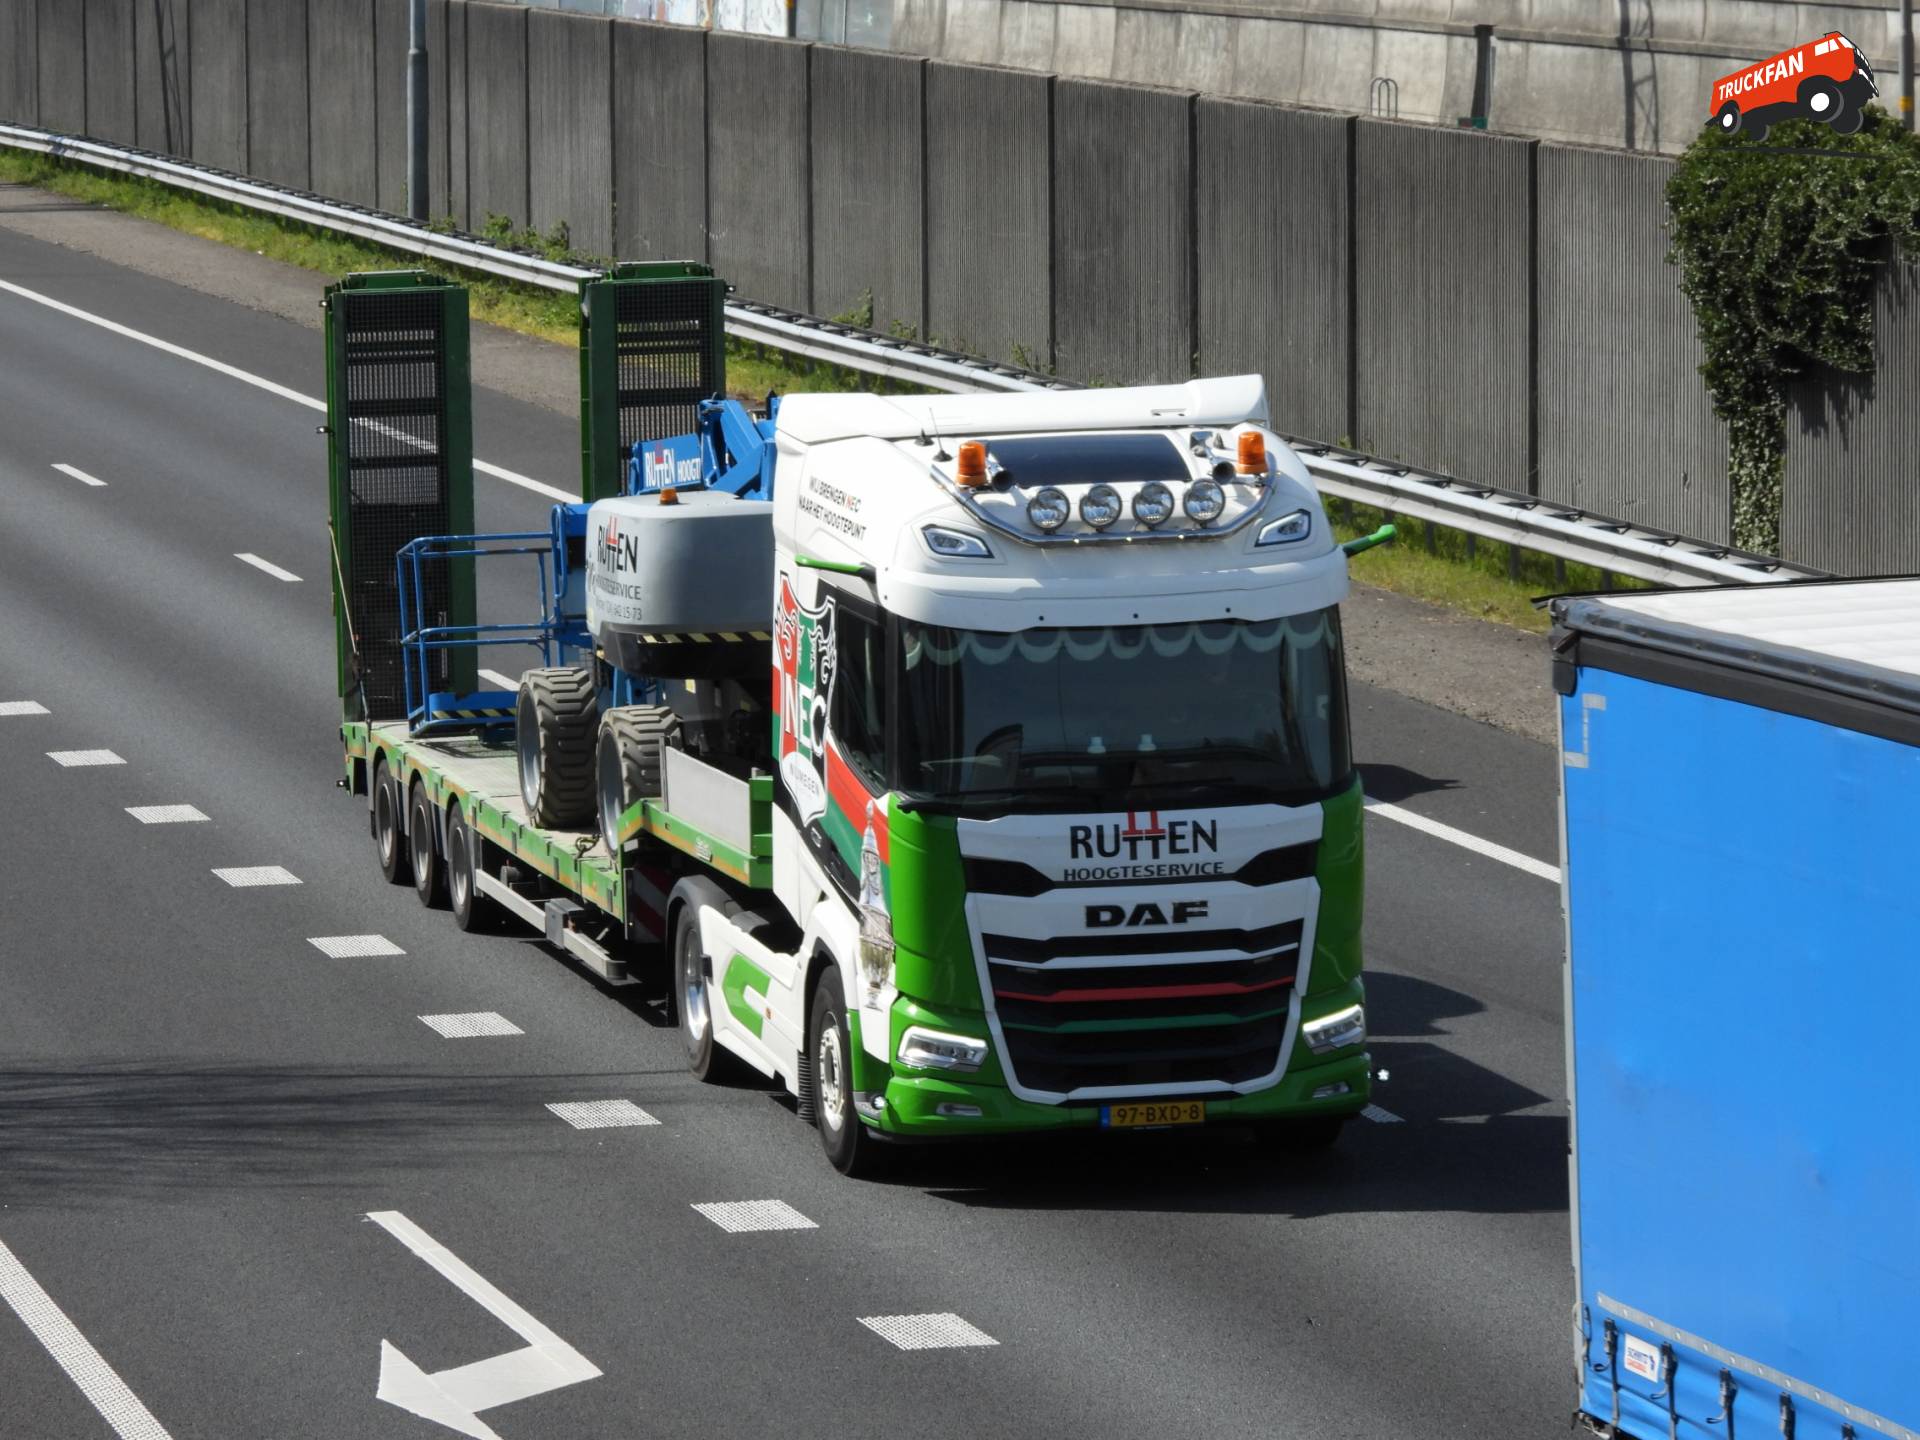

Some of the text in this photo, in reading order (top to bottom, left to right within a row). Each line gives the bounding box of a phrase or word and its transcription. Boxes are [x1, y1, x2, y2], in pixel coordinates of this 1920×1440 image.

[645, 444, 675, 488] RUTTEN
[799, 494, 867, 541] NAAR HET HOOGTEPUNT
[819, 480, 848, 508] BRENGEN
[846, 495, 861, 513] NEC
[598, 516, 639, 574] RUTTEN
[784, 671, 827, 758] NEC
[1069, 809, 1218, 861] RUTTEN
[1063, 861, 1225, 881] HOOGTESERVICE
[1085, 900, 1209, 929] DAF
[1116, 1103, 1200, 1124] 97-BXD-8
